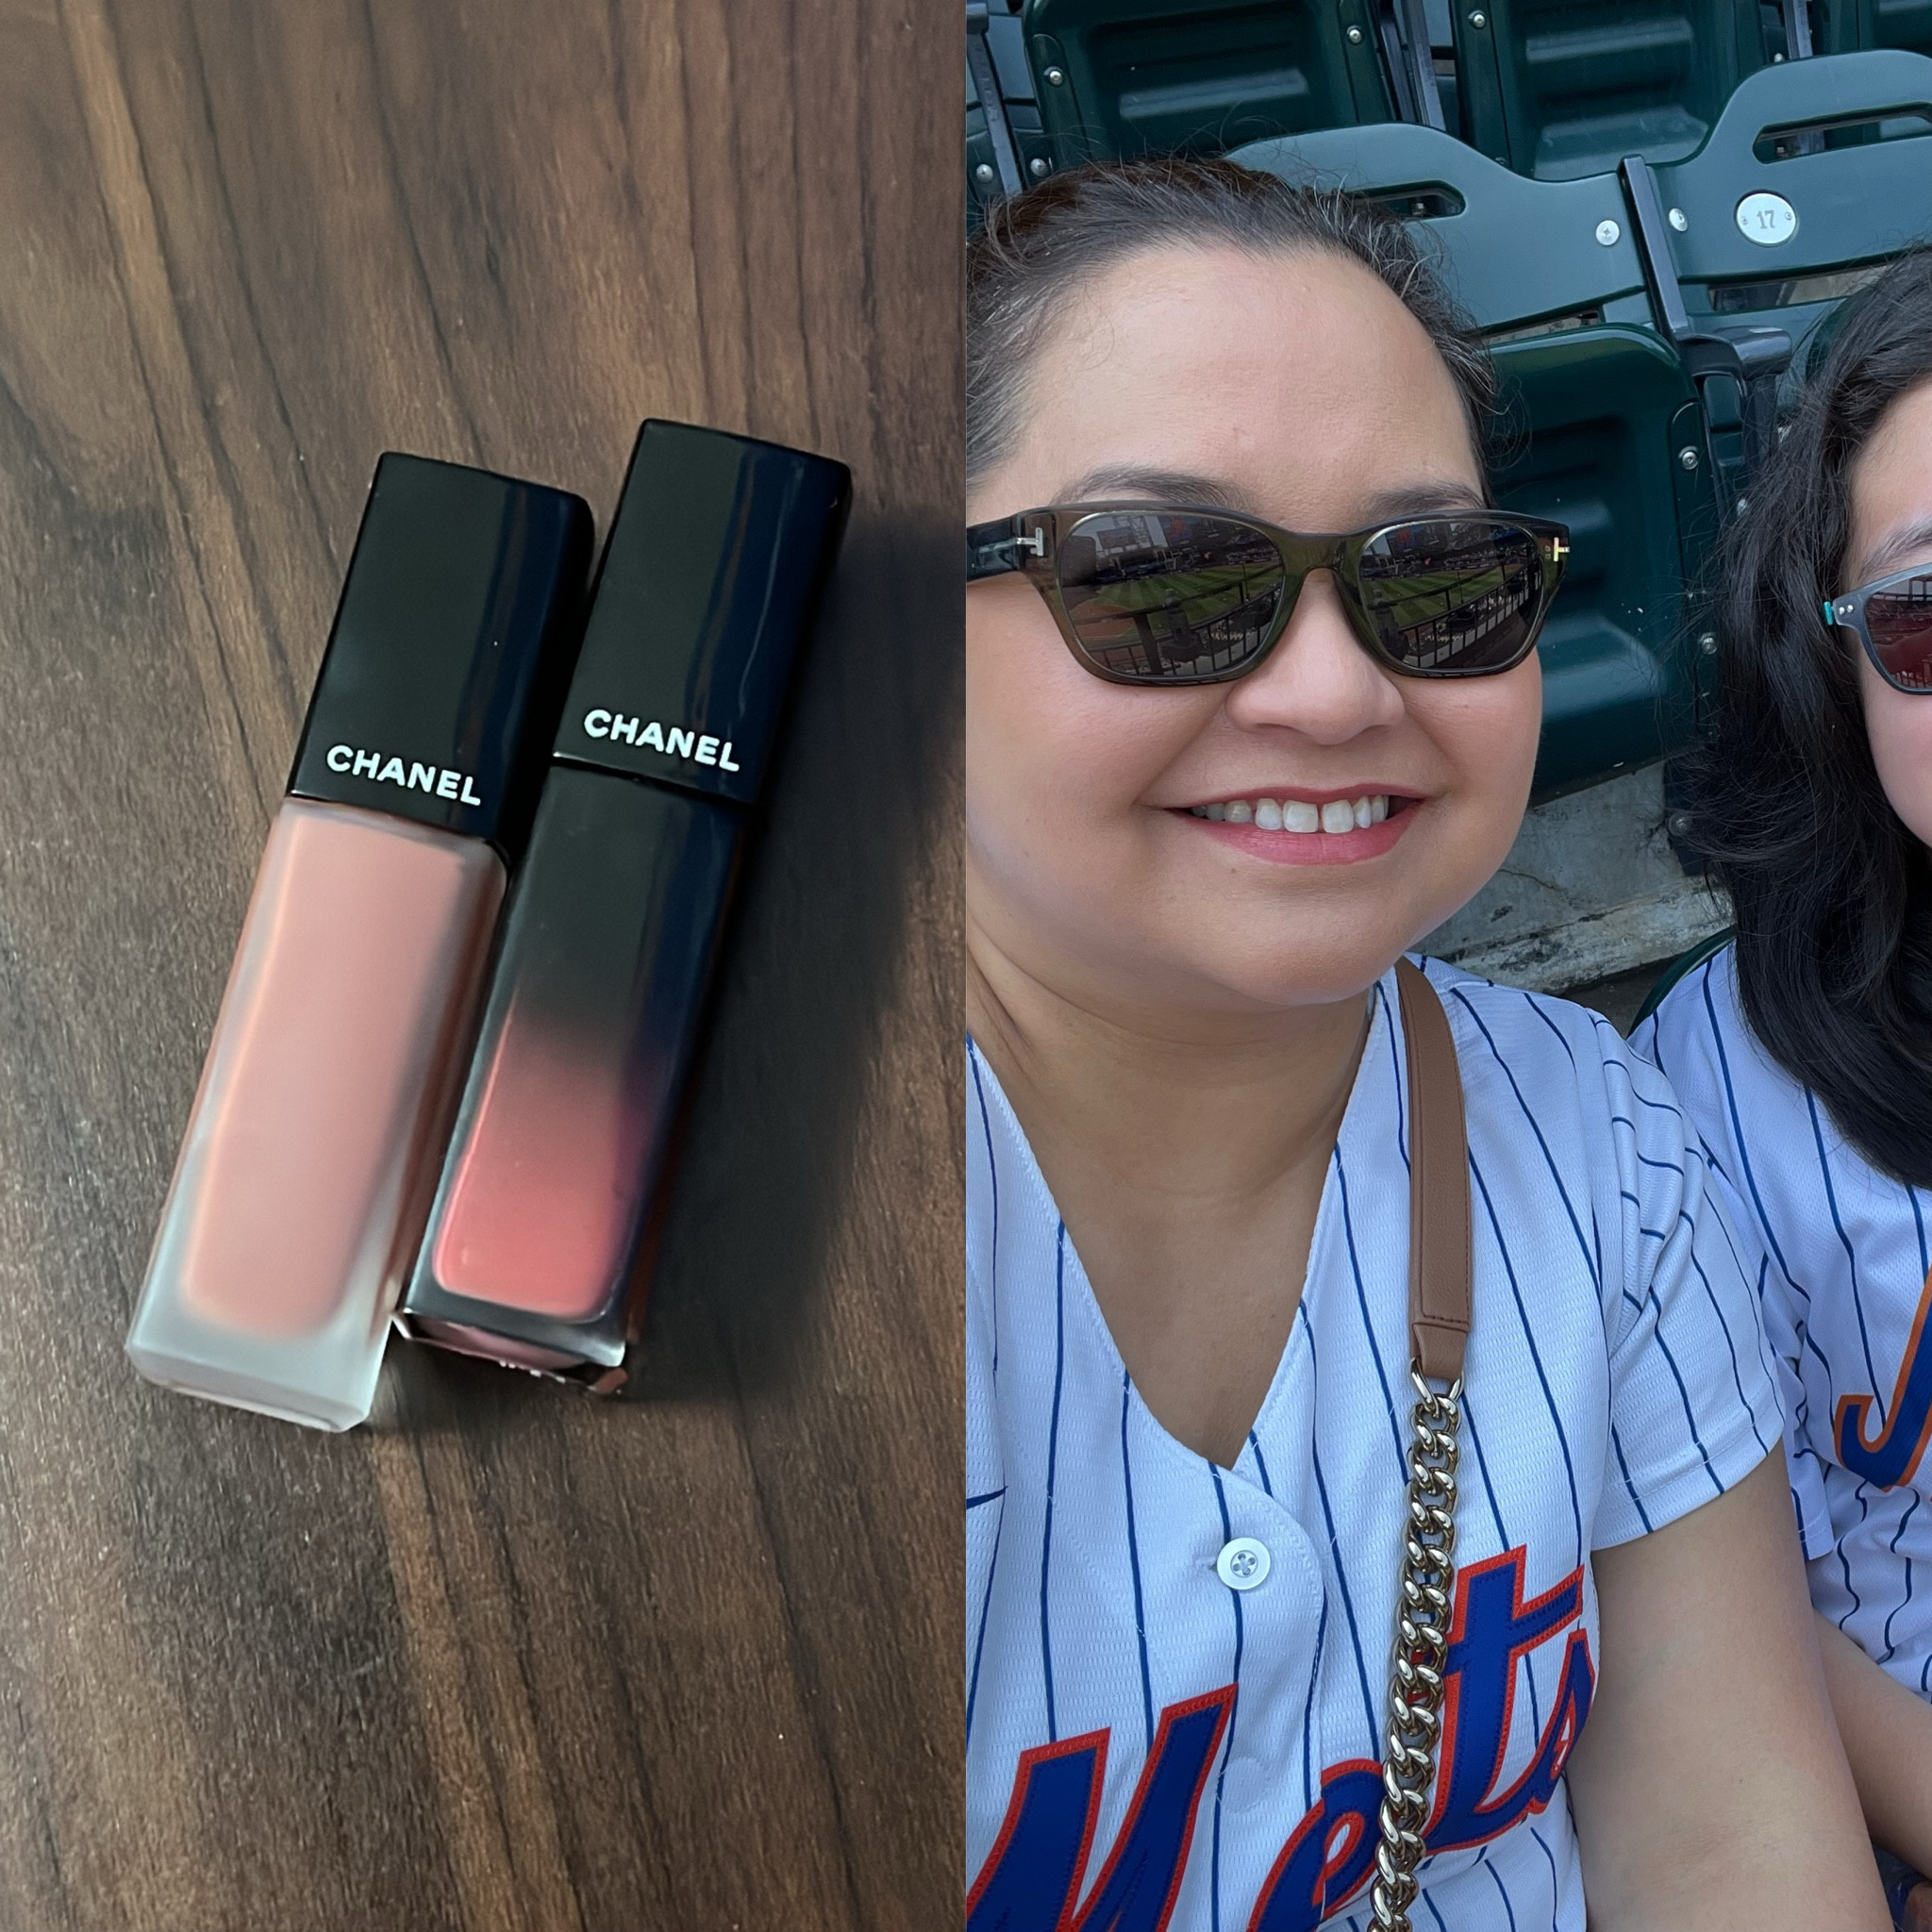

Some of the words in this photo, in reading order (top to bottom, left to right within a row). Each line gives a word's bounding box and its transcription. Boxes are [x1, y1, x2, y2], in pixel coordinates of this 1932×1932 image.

[1756, 209, 1775, 229] 17
[583, 708, 741, 773] CHANEL
[326, 744, 482, 807] CHANEL
